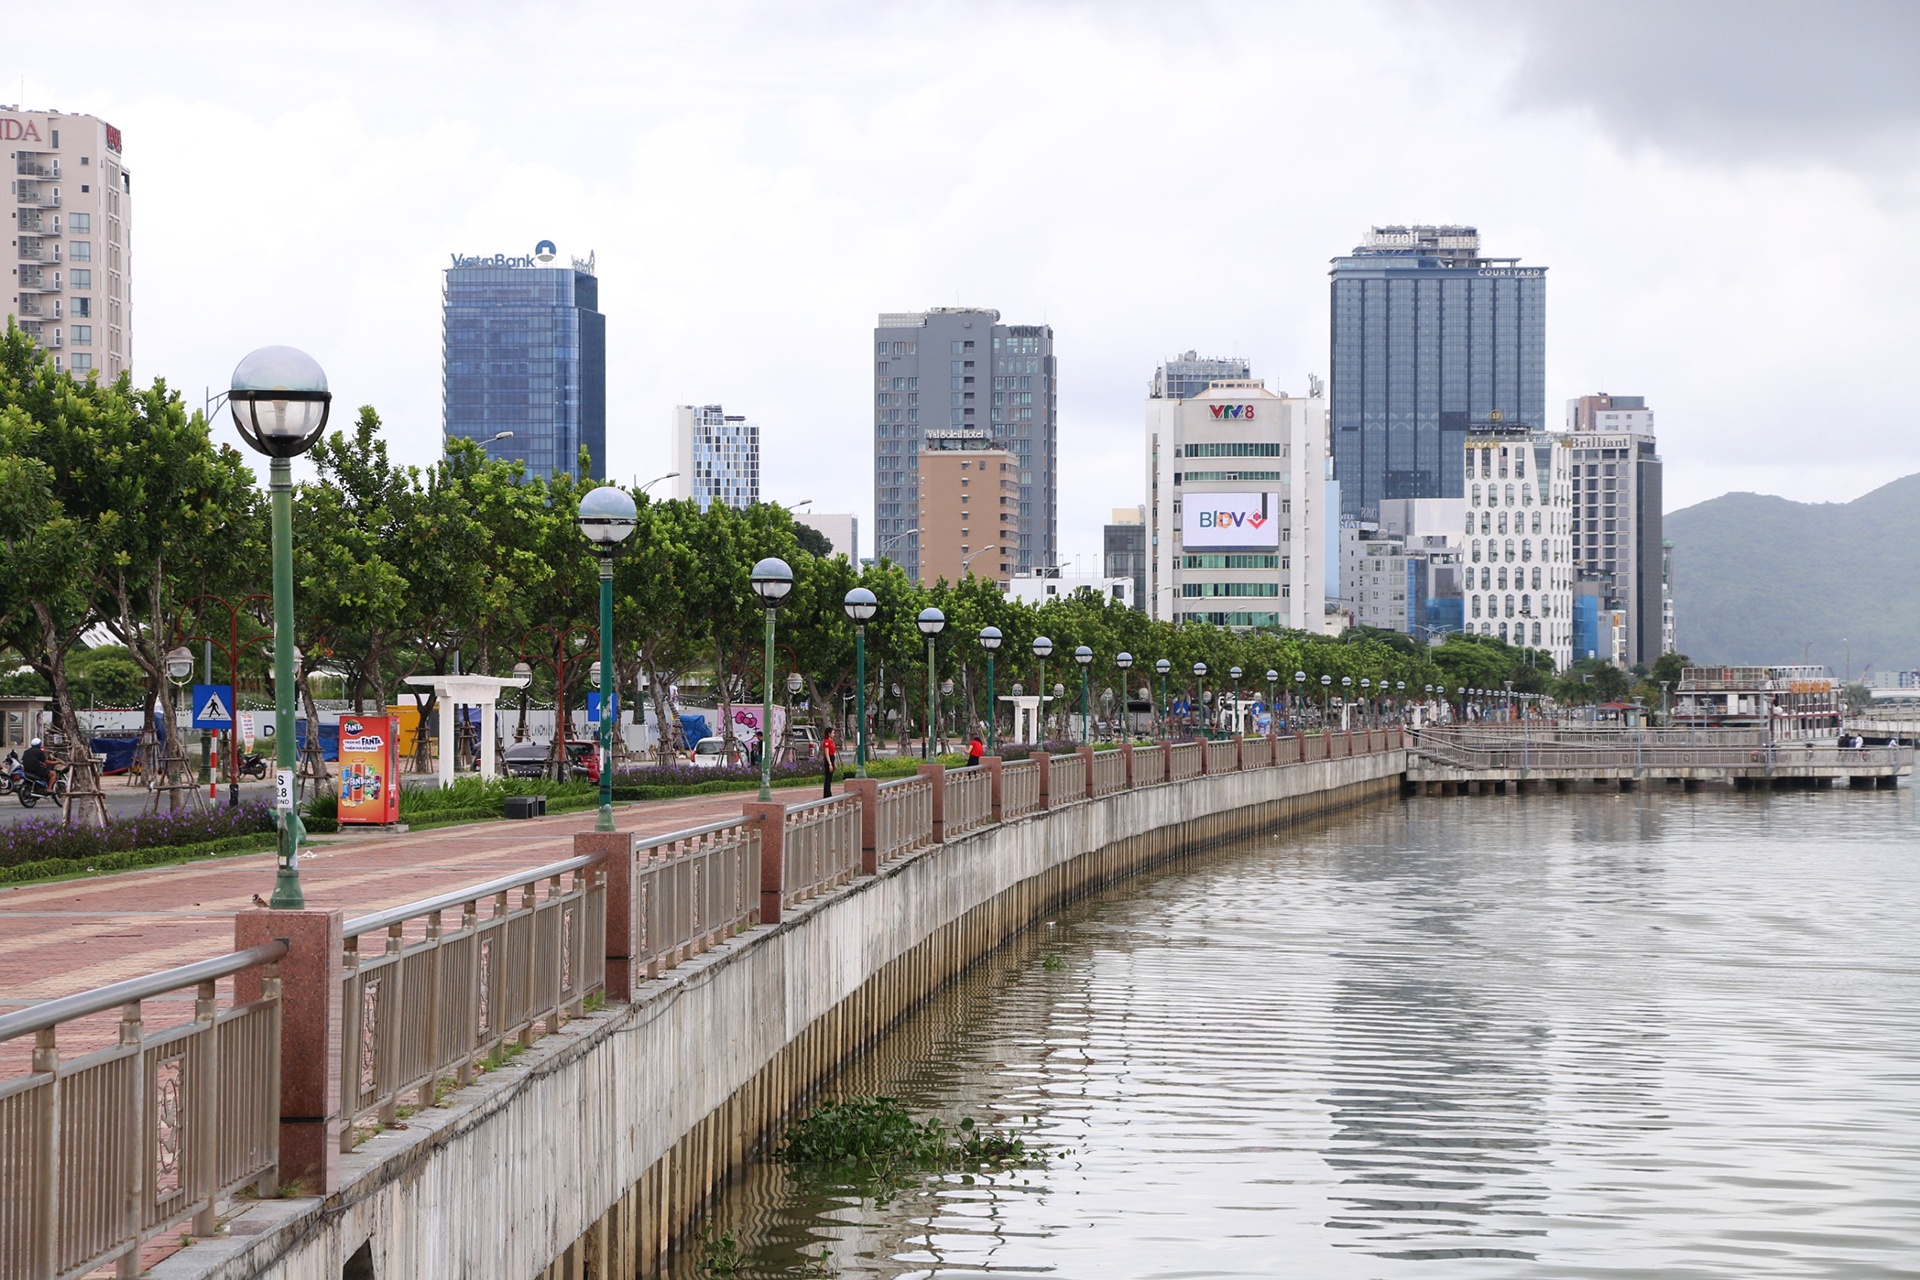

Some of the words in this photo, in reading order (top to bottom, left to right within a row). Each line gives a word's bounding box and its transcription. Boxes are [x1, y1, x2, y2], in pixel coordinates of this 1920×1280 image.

[1477, 268, 1540, 277] COURTYARD
[1009, 326, 1042, 337] WINK
[1209, 404, 1255, 420] VTV8
[963, 429, 984, 439] Hotel
[1572, 436, 1628, 448] Brilliant
[1200, 510, 1246, 528] BIDV
[344, 723, 363, 732] FANTA
[361, 737, 381, 745] FANTA
[278, 775, 285, 786] S
